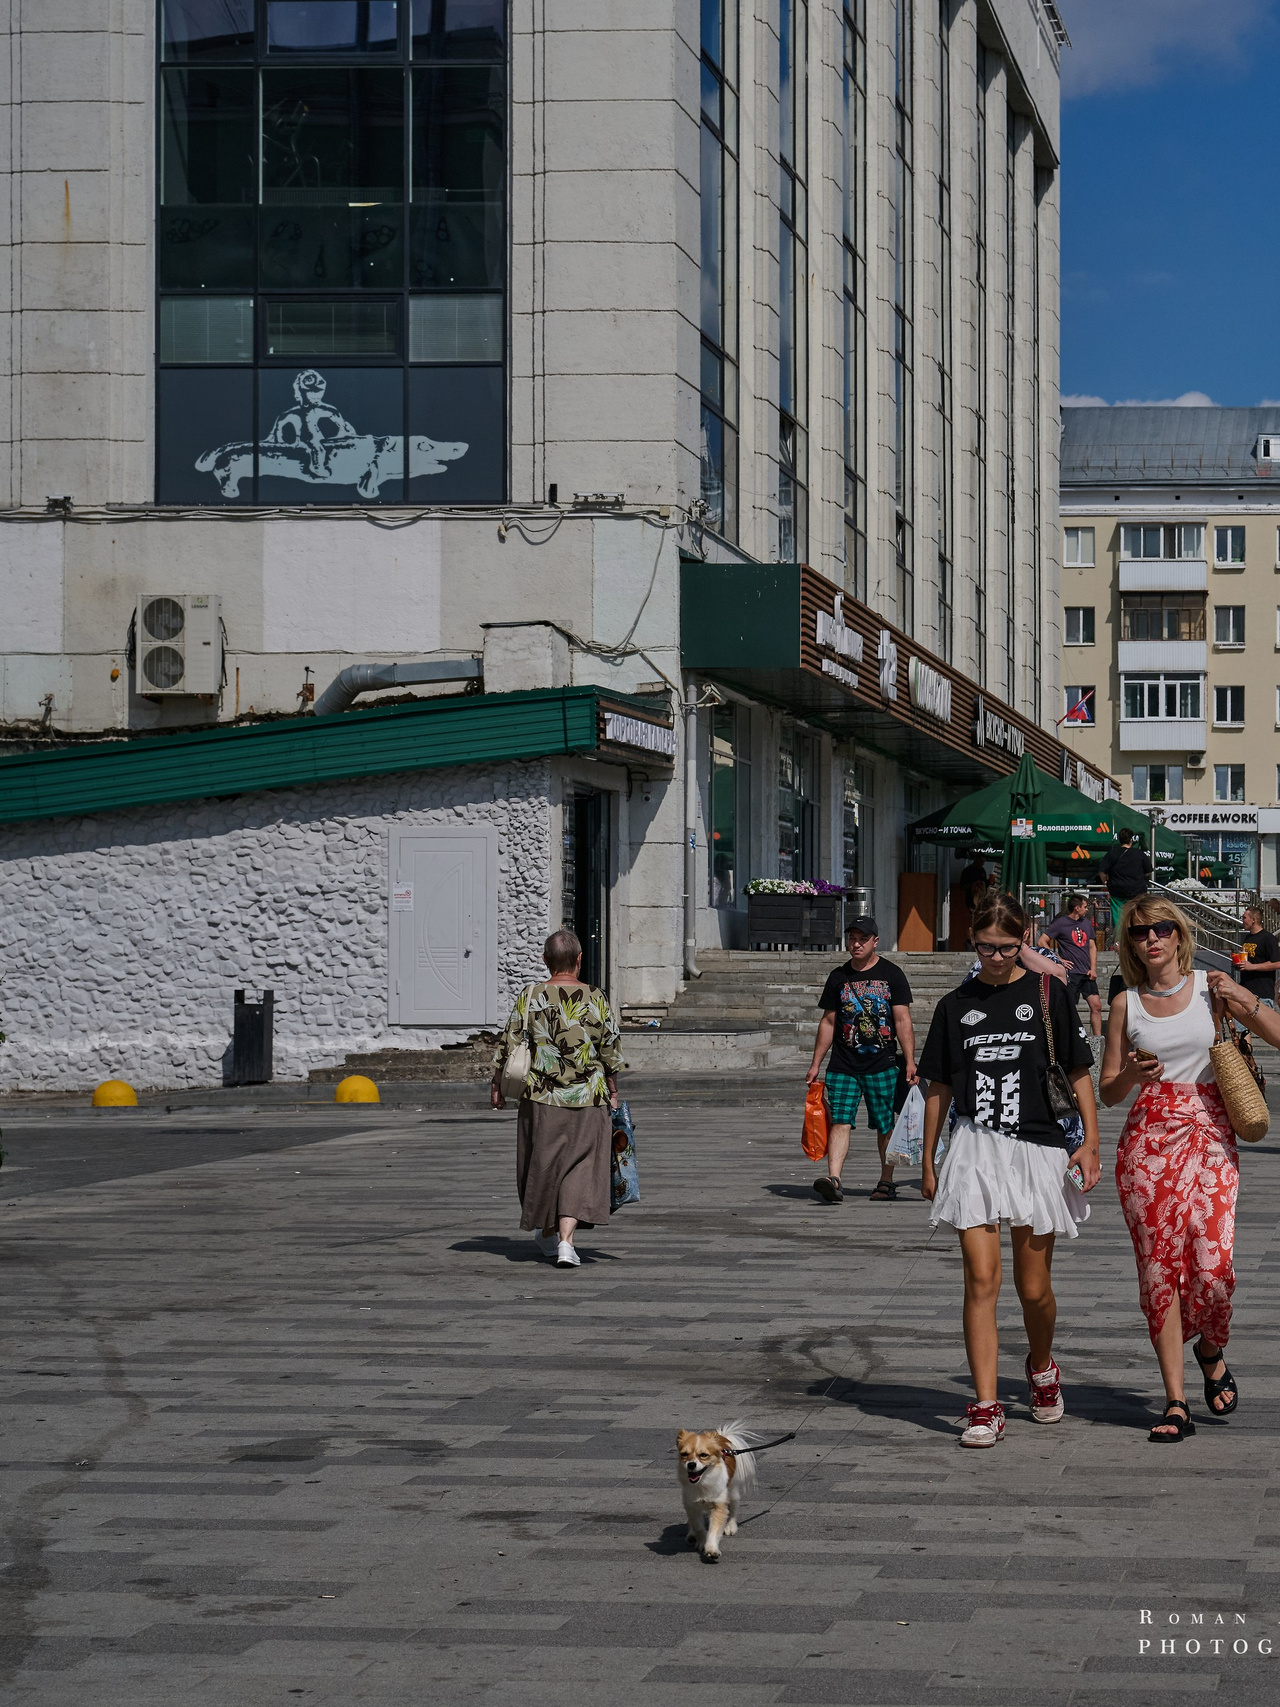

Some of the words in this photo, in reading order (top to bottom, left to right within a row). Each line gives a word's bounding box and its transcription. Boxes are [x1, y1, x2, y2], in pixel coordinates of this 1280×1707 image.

[1170, 813, 1210, 823] COFFEE
[1037, 824, 1092, 833] Велопарковка
[963, 1031, 1036, 1050] ПЕРМЬ
